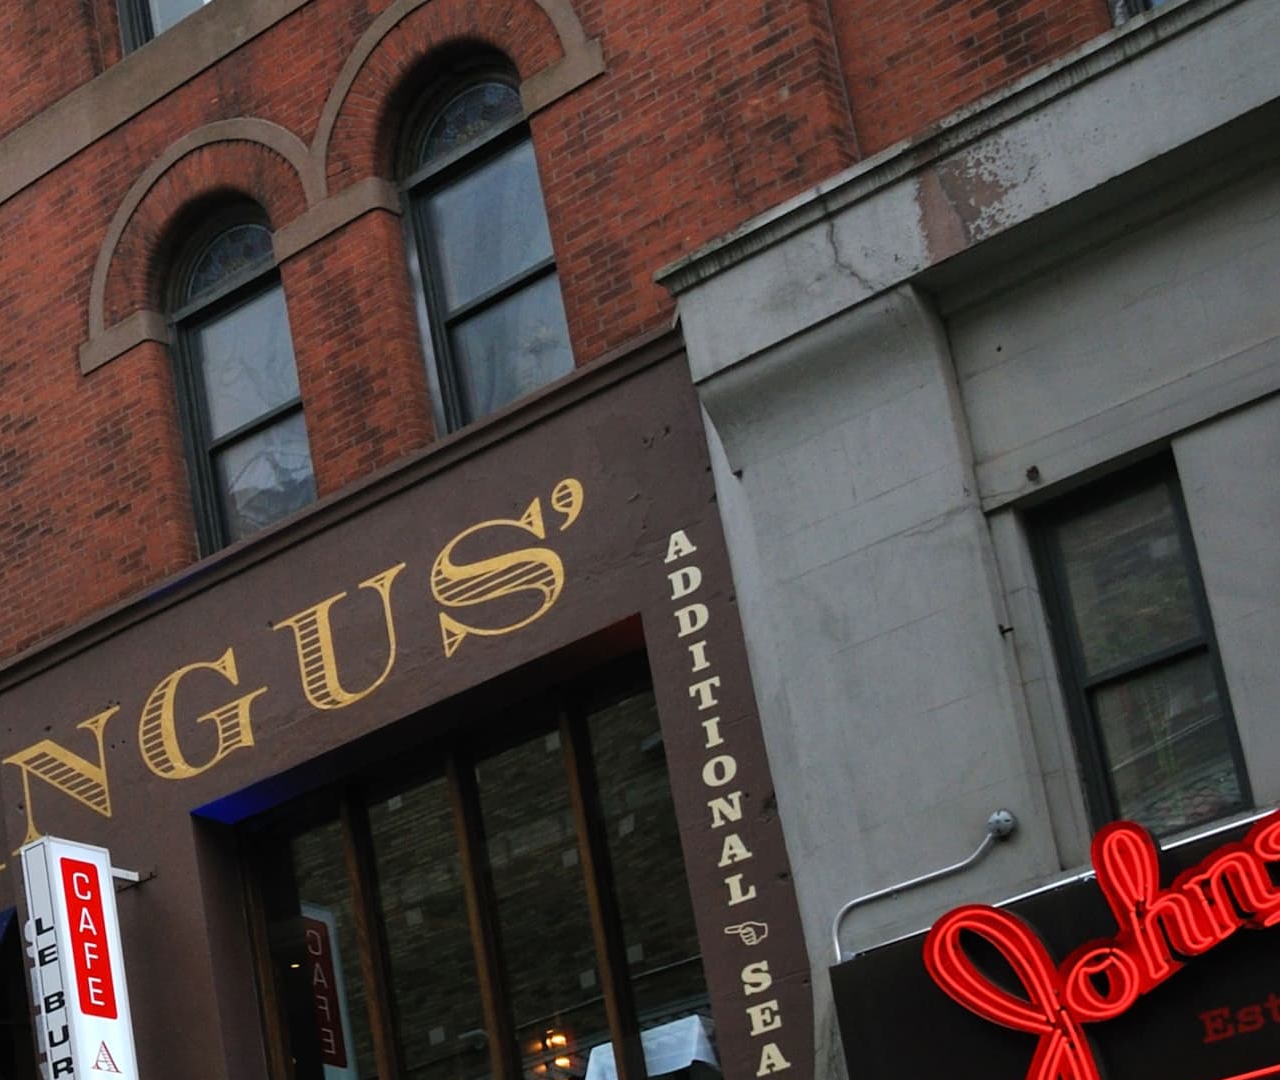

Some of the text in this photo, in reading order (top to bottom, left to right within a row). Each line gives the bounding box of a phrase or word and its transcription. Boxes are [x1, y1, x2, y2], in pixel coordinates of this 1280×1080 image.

[664, 530, 756, 906] ADDITIONAL
[35, 917, 59, 967] LE
[71, 871, 104, 1008] CAFE
